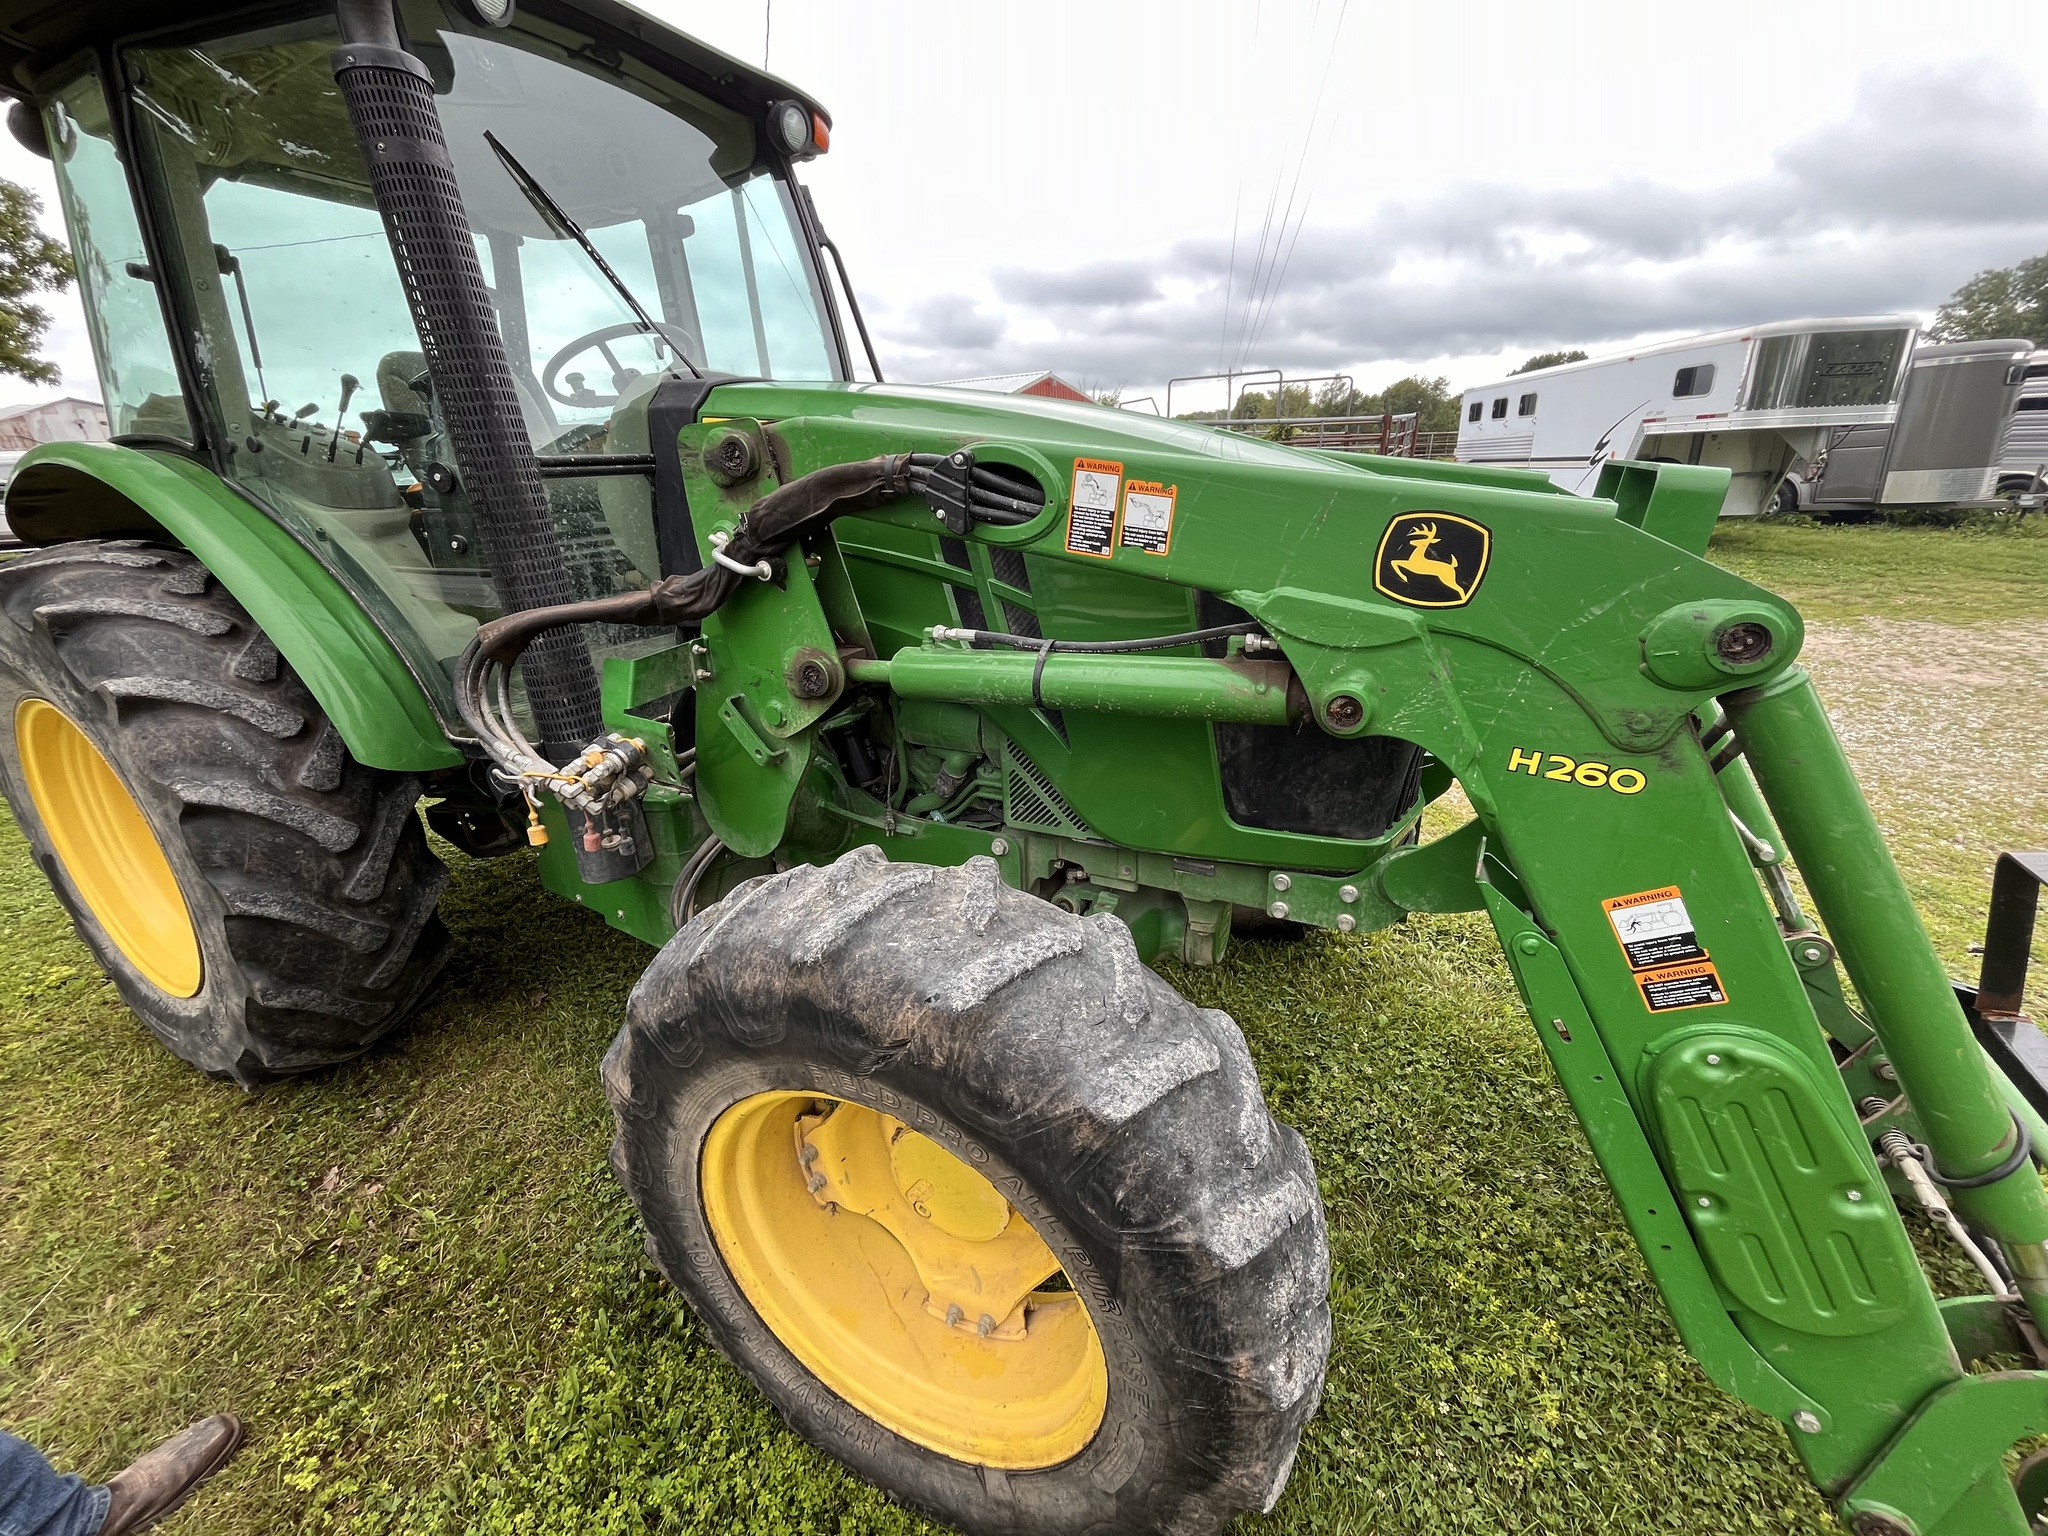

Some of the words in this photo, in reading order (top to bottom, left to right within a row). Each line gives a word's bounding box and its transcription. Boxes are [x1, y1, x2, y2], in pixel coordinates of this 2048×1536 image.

[1086, 462, 1120, 473] WARNING
[1138, 484, 1173, 496] WARNING
[1622, 890, 1674, 907] WARNING
[1656, 966, 1706, 981] WARNING
[803, 1061, 902, 1110] FIELD
[915, 1102, 991, 1164] PRO
[998, 1175, 1062, 1234] ALL
[1062, 1246, 1151, 1411] PURPOSE
[686, 1249, 748, 1324] KING
[740, 1332, 883, 1460] HARVEST
